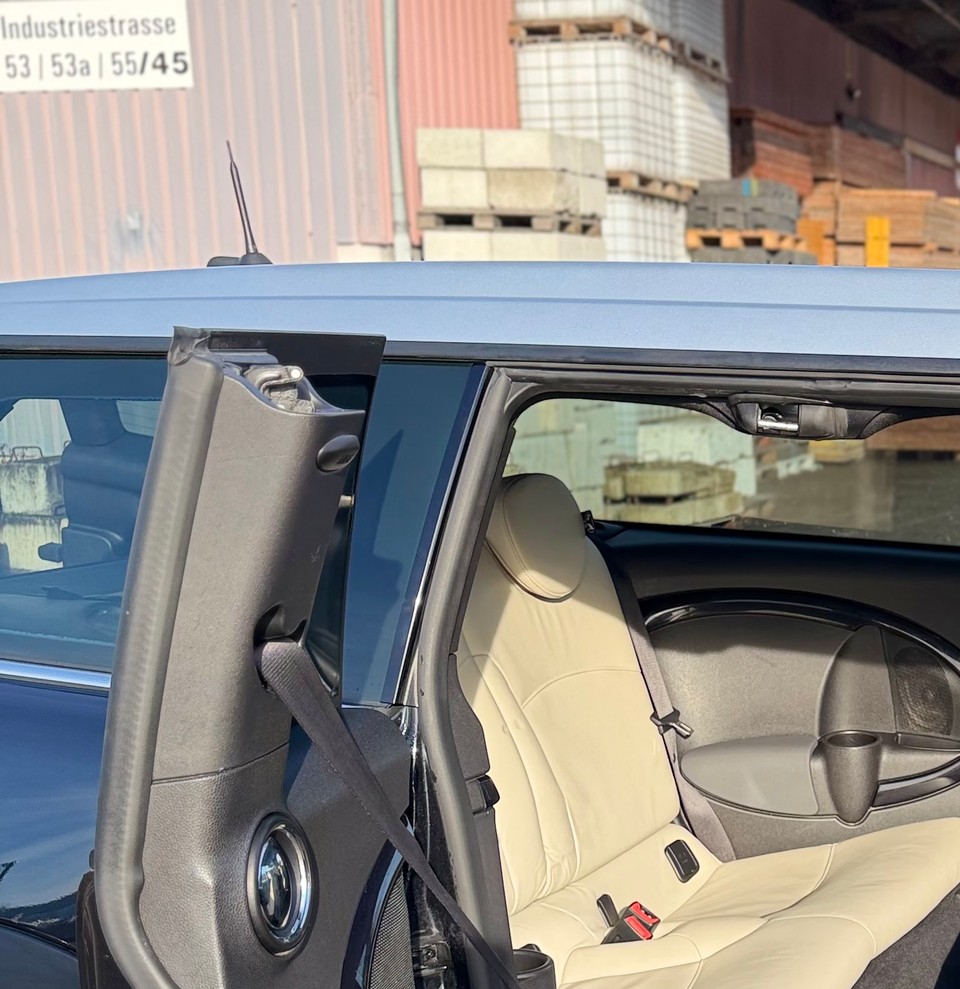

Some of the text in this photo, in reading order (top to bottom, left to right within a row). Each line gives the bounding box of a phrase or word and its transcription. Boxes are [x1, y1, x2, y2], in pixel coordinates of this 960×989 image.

[0, 13, 176, 39] Industriestrasse
[5, 54, 31, 79] 53
[51, 52, 90, 78] 53a
